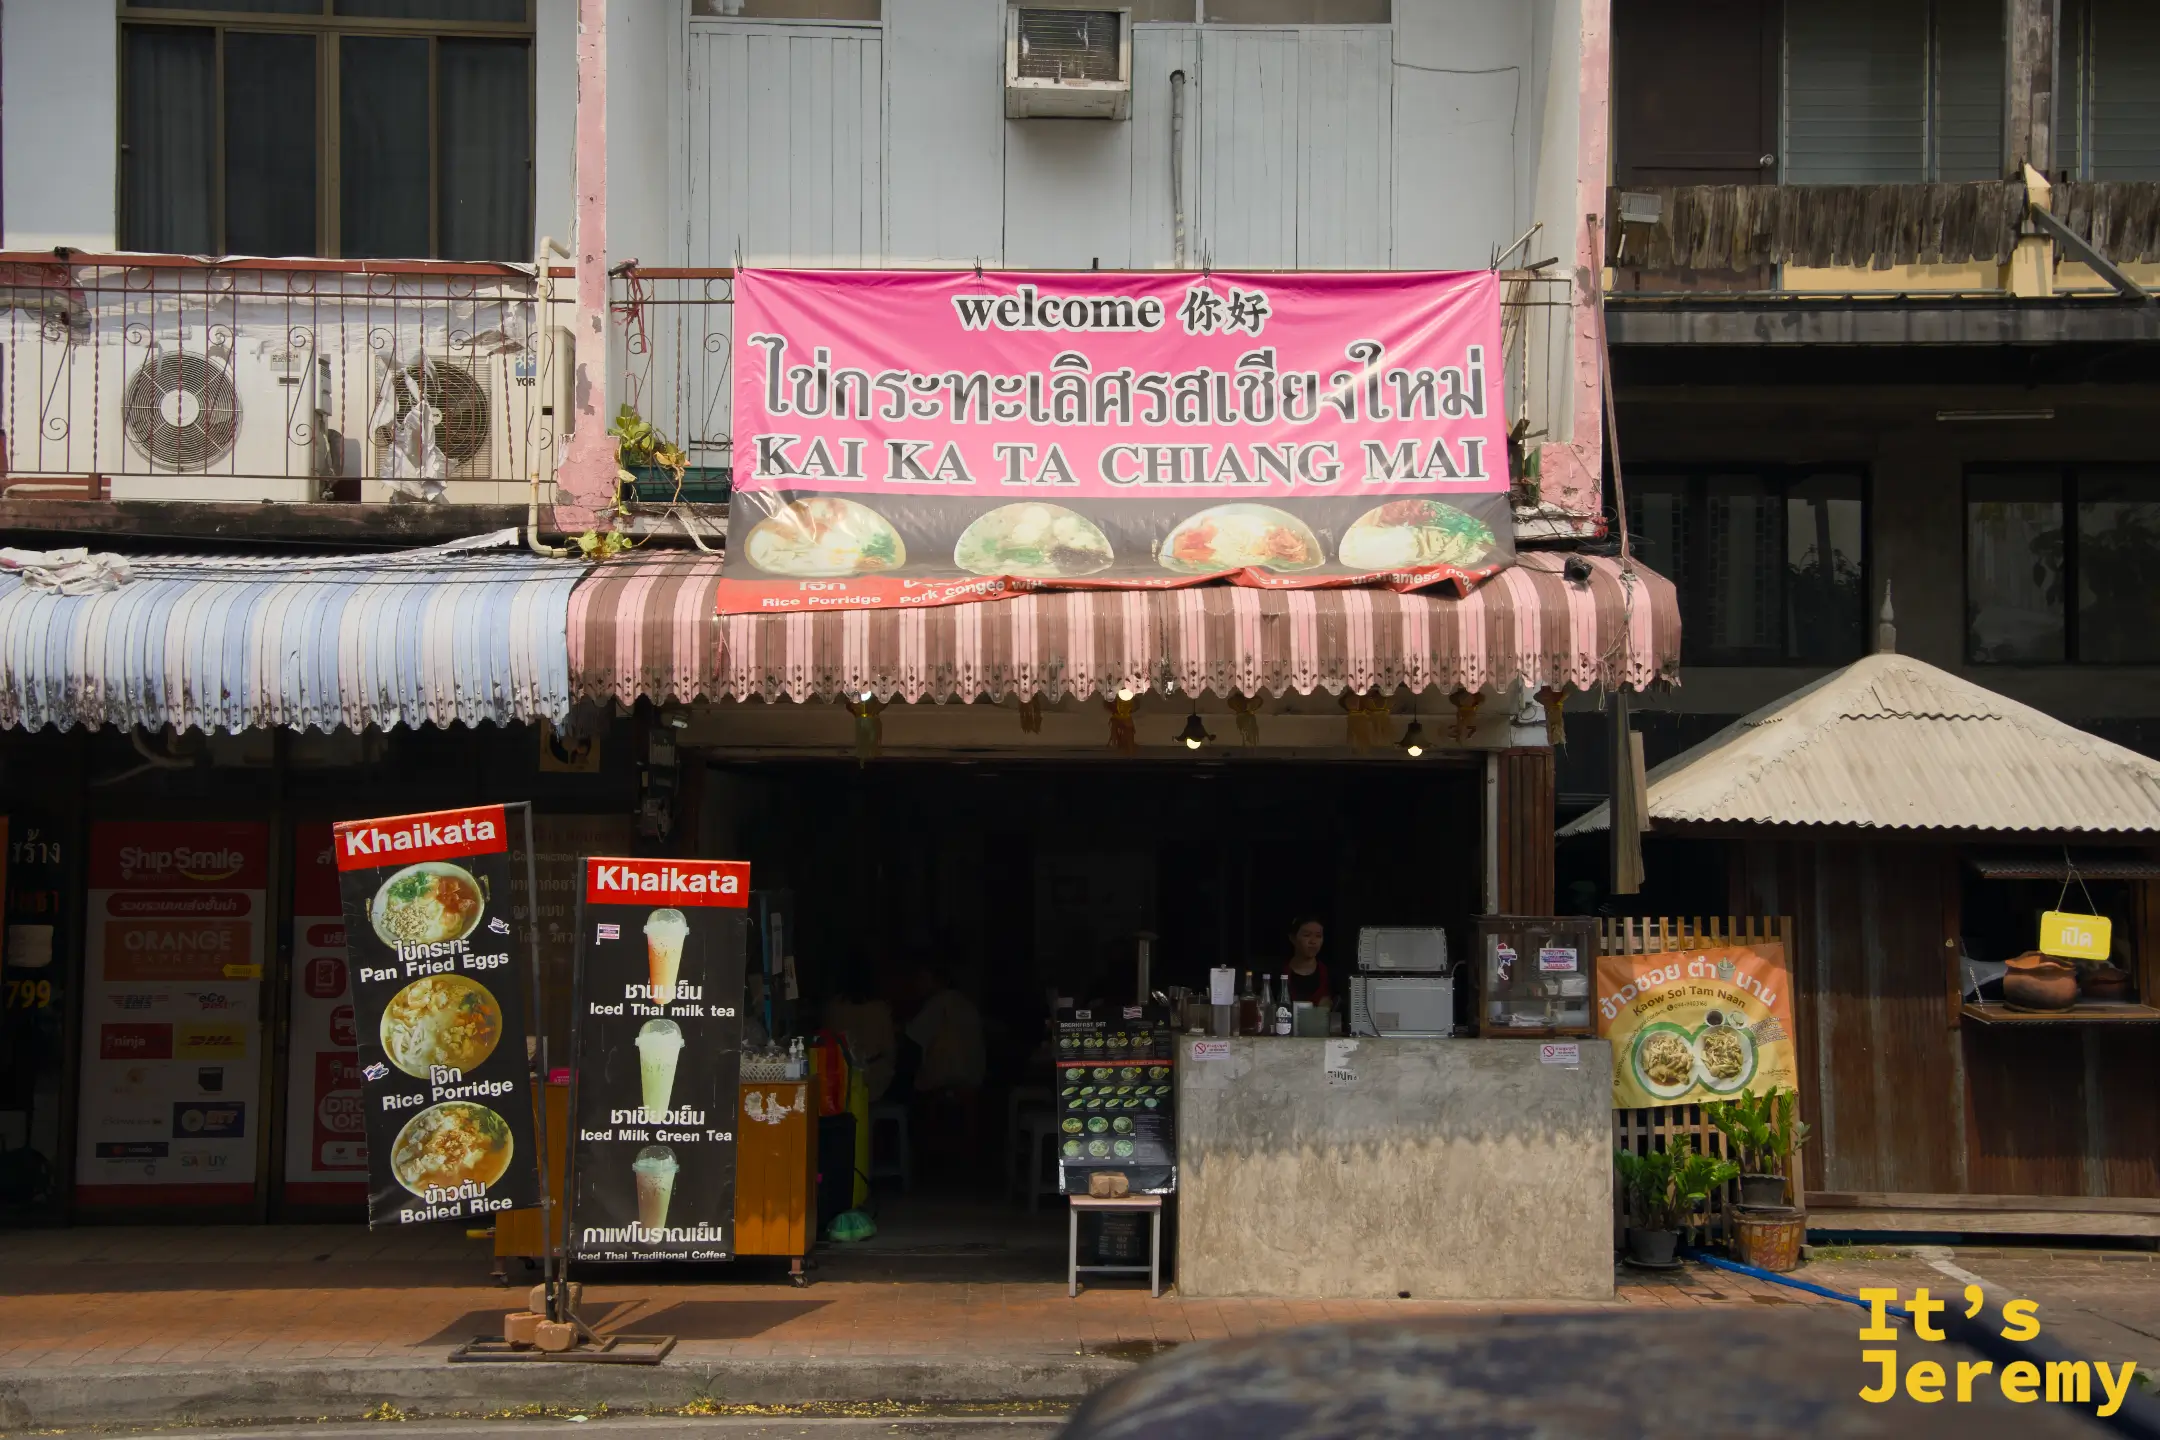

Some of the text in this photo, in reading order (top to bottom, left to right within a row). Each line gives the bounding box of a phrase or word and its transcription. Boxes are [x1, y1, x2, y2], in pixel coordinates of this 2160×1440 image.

[954, 287, 1269, 335] welcome 你好
[750, 336, 1486, 425] ไข่กระทะเลิศรสเชียงใหม่
[754, 436, 1488, 485] KAI KA TA CHIANG MAI
[762, 595, 882, 607] Rice Porridge
[899, 589, 939, 604] Pork
[945, 579, 1006, 597] congee
[345, 817, 496, 856] Khaikata
[596, 866, 739, 894] Khaikata
[124, 930, 233, 951] ORANGE
[392, 939, 470, 962] ไข่กระทะ
[359, 952, 510, 983] Pan Fried Eggs
[1601, 962, 1681, 1020] ข้าวซอย
[1632, 985, 1747, 1018] Kaow Soi Tam Naan
[589, 1002, 735, 1017] Iced Thai milk tea
[114, 1036, 146, 1049] ninja
[429, 1064, 463, 1087] โจ๊ก
[382, 1079, 514, 1111] Rice Porridge
[610, 1104, 705, 1125] ชาเขียวเย็น
[580, 1129, 732, 1142] Iced Milk Green Tea
[424, 1178, 487, 1205] ข้าวต้ม
[400, 1197, 513, 1224] Boiled Rice
[583, 1220, 722, 1243] กาแฟโบราณเย็น
[577, 1250, 727, 1261] Iced Thai Traditional Coffee
